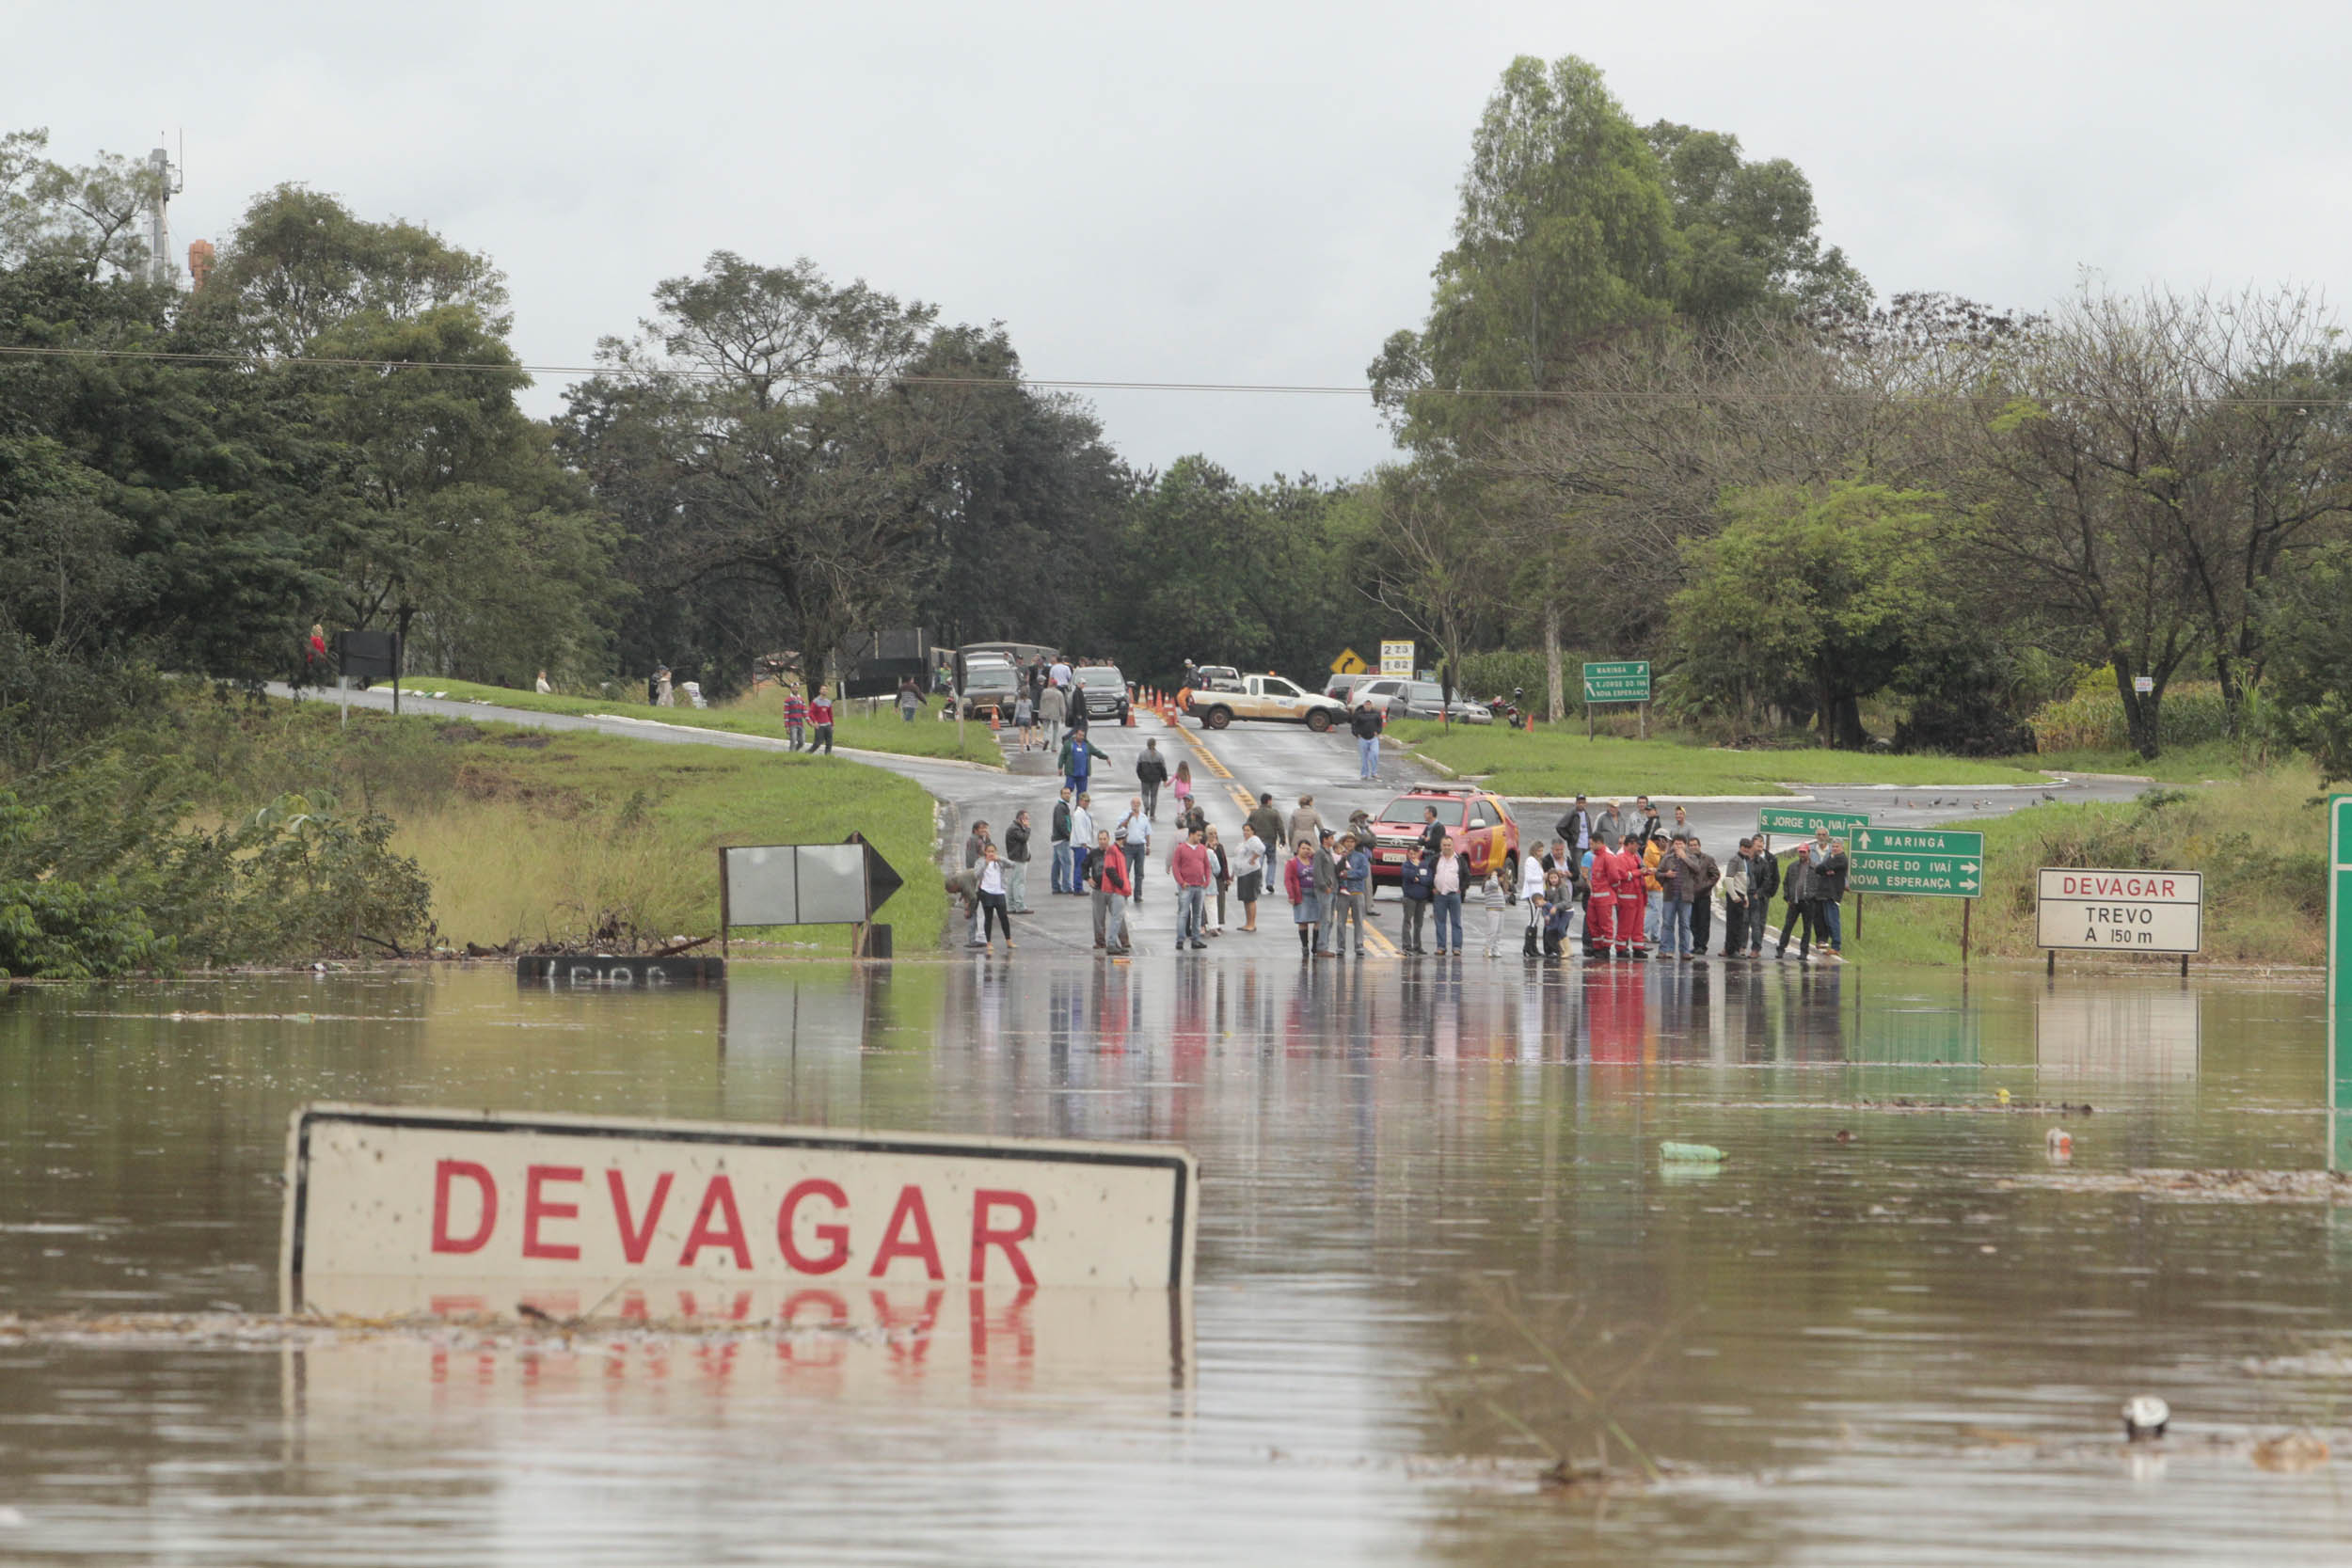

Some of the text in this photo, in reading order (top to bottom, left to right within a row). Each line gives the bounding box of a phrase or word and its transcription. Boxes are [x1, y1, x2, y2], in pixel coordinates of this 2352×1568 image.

[1772, 816, 1804, 828] JORGE
[1809, 818, 1823, 829] DO
[1828, 818, 1847, 831] IVAÍ
[1883, 835, 1945, 848] MARINGÁ
[1904, 861, 1920, 871] DO
[1930, 860, 1951, 873] IVAÍ
[1850, 875, 1951, 890] NOVA ESPERANÇA
[2063, 877, 2175, 897] DEVAGAR
[2086, 907, 2153, 925] TREVO
[2085, 927, 2153, 943] A 150 m
[432, 1159, 1038, 1285] DEVAGAR
